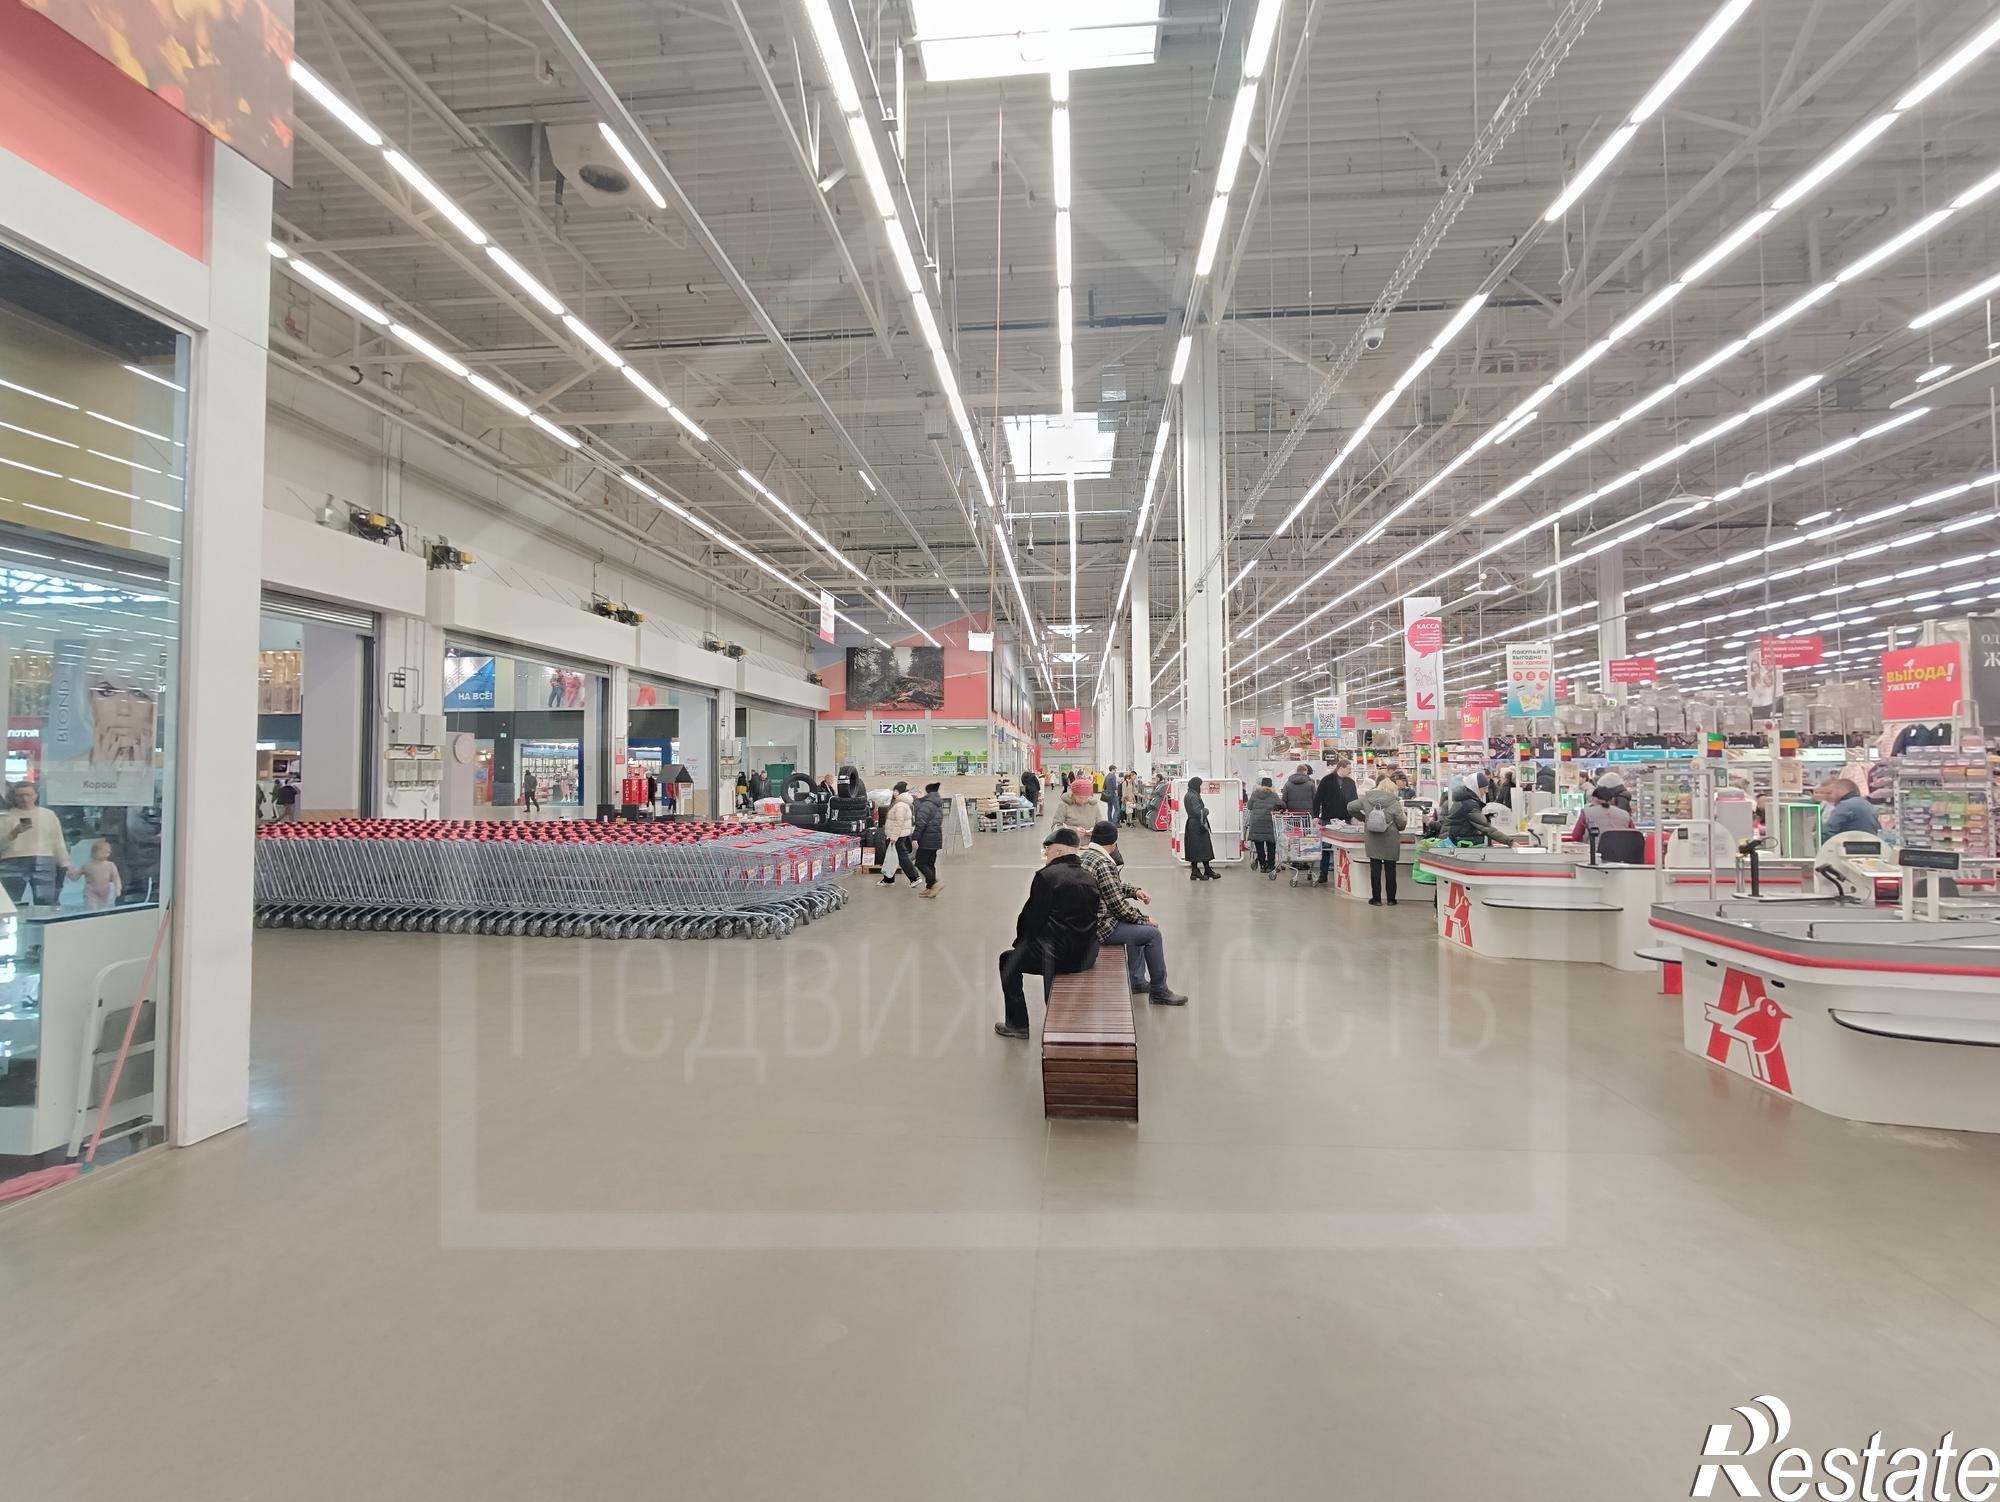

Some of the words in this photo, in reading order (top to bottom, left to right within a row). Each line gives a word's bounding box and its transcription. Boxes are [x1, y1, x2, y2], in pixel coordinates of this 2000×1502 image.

[1886, 663, 1955, 682] ВЫГОДА!
[1888, 683, 1904, 692] УЖЕ
[1905, 682, 1920, 690] ТУТ
[458, 692, 471, 700] НА
